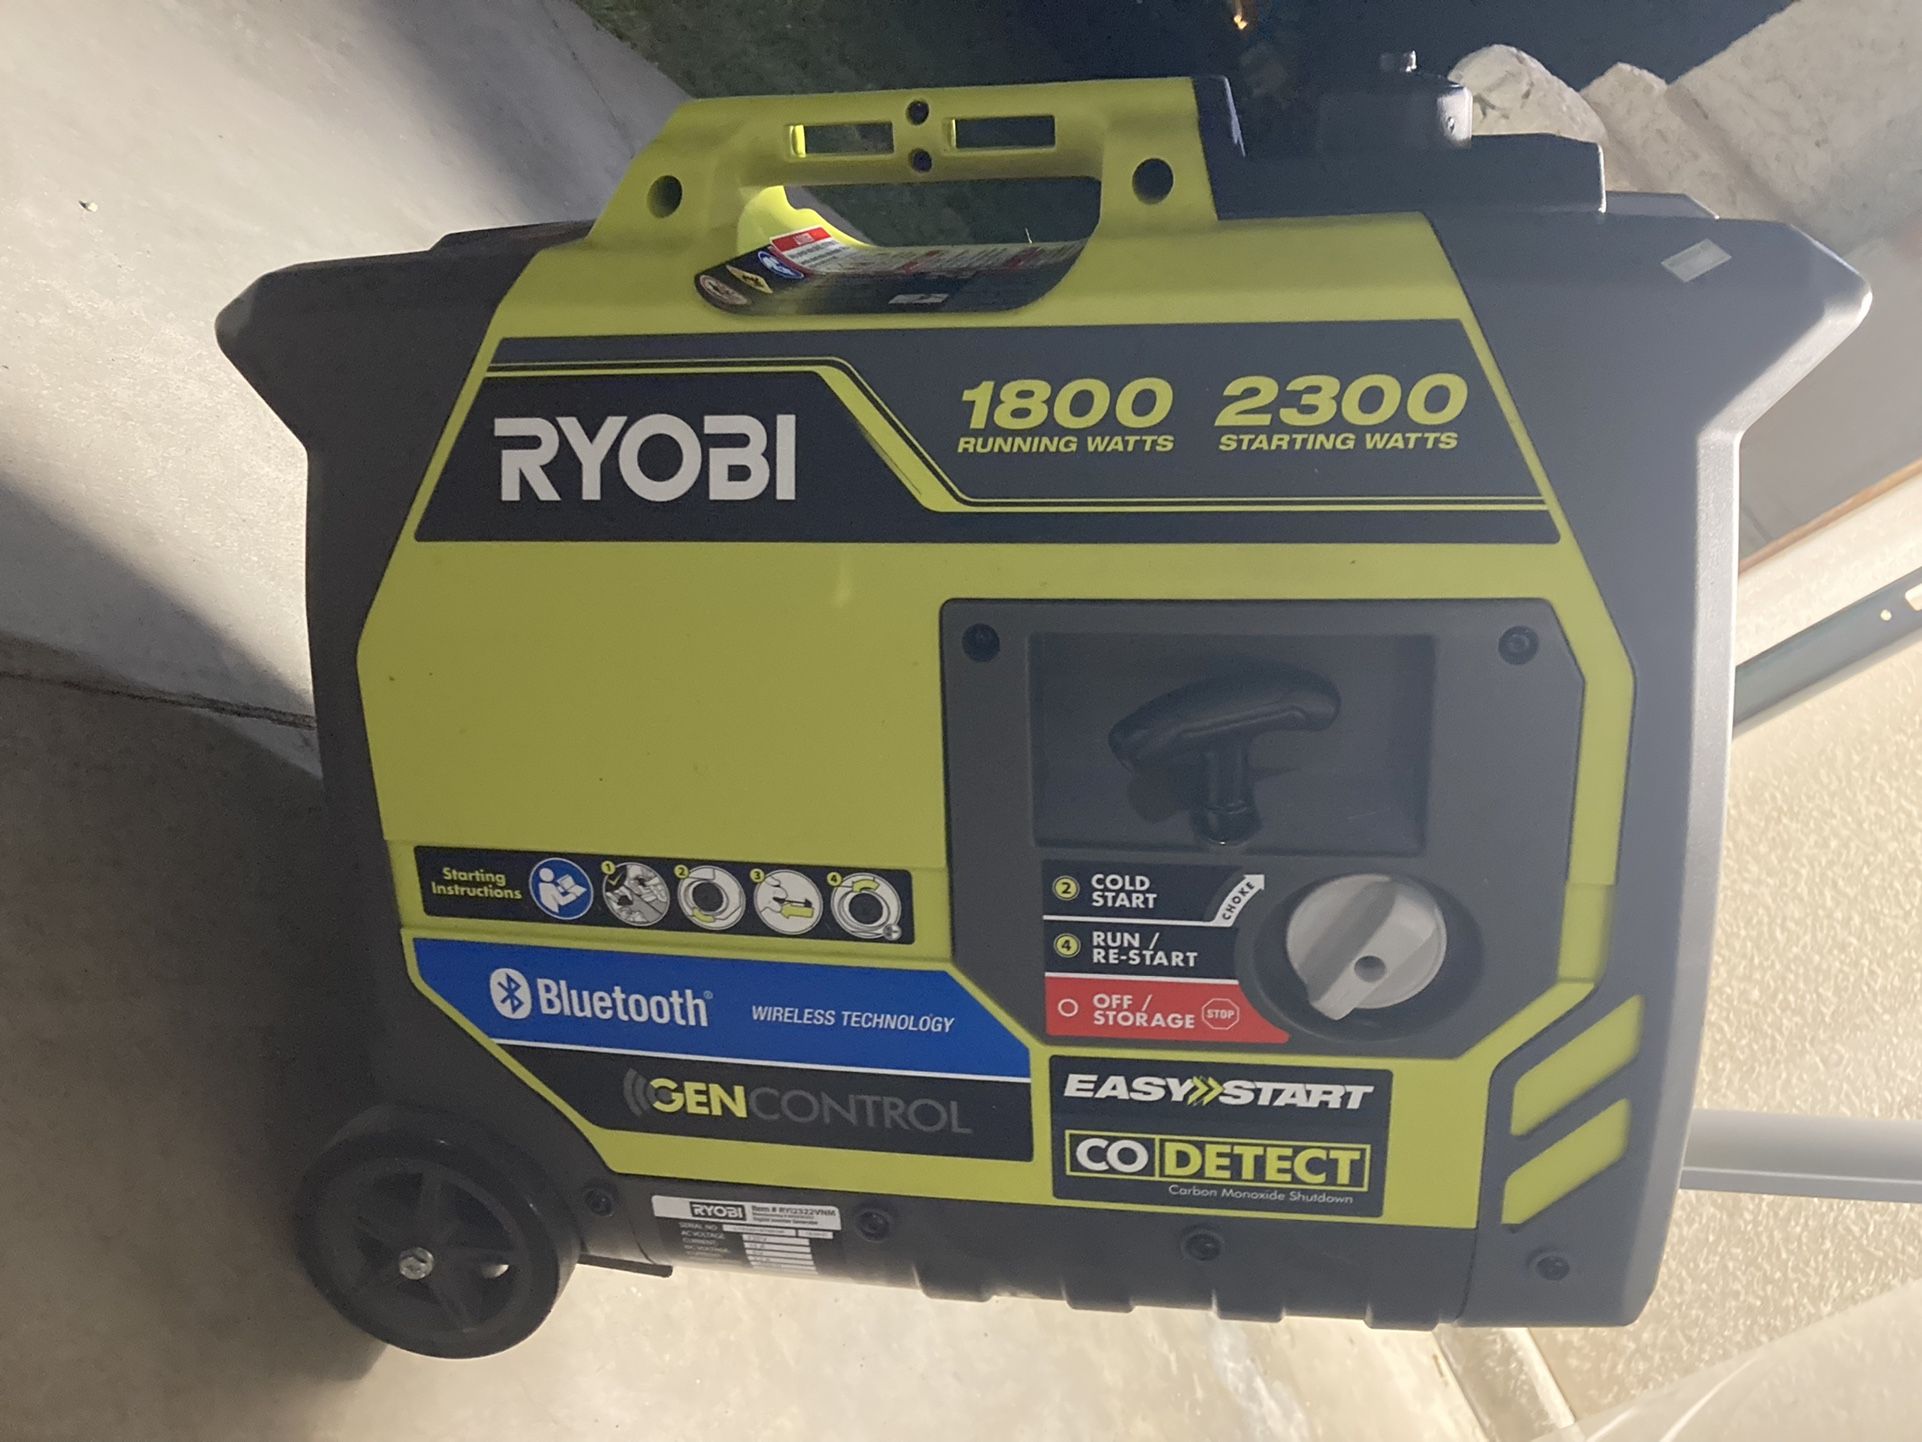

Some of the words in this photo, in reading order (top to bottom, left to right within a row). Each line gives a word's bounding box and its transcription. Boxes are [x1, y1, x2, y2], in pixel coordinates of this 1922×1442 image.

[961, 377, 1174, 432] 1800
[1213, 373, 1469, 427] 2300
[957, 435, 1078, 453] RUNNING
[1087, 435, 1175, 453] WATTS
[1218, 433, 1356, 451] STARTING
[1365, 432, 1459, 450] WATTS
[494, 413, 796, 501] RYOBI
[442, 867, 506, 886] Starting
[1091, 873, 1151, 891] COLD
[431, 882, 523, 900] Instructions
[1061, 882, 1071, 894] 2
[1091, 891, 1157, 909] START
[1222, 881, 1255, 921] CHOKE
[1061, 939, 1071, 951] 4
[1092, 931, 1140, 948] RUN
[1092, 949, 1198, 967] RE-START
[1092, 993, 1133, 1010] OFF
[751, 1004, 836, 1026] WIRELESS
[840, 1010, 955, 1034] TECHNOLOGY
[1093, 1010, 1195, 1029] STORAGE
[1206, 1009, 1235, 1019] STOP
[1075, 1137, 1149, 1173] CO
[1163, 1140, 1361, 1185] DETECT
[1168, 1184, 1217, 1198] Carbon
[1221, 1187, 1285, 1202] Monoxide
[1289, 1190, 1354, 1204] Shutdown
[692, 1204, 744, 1219] RYOBI
